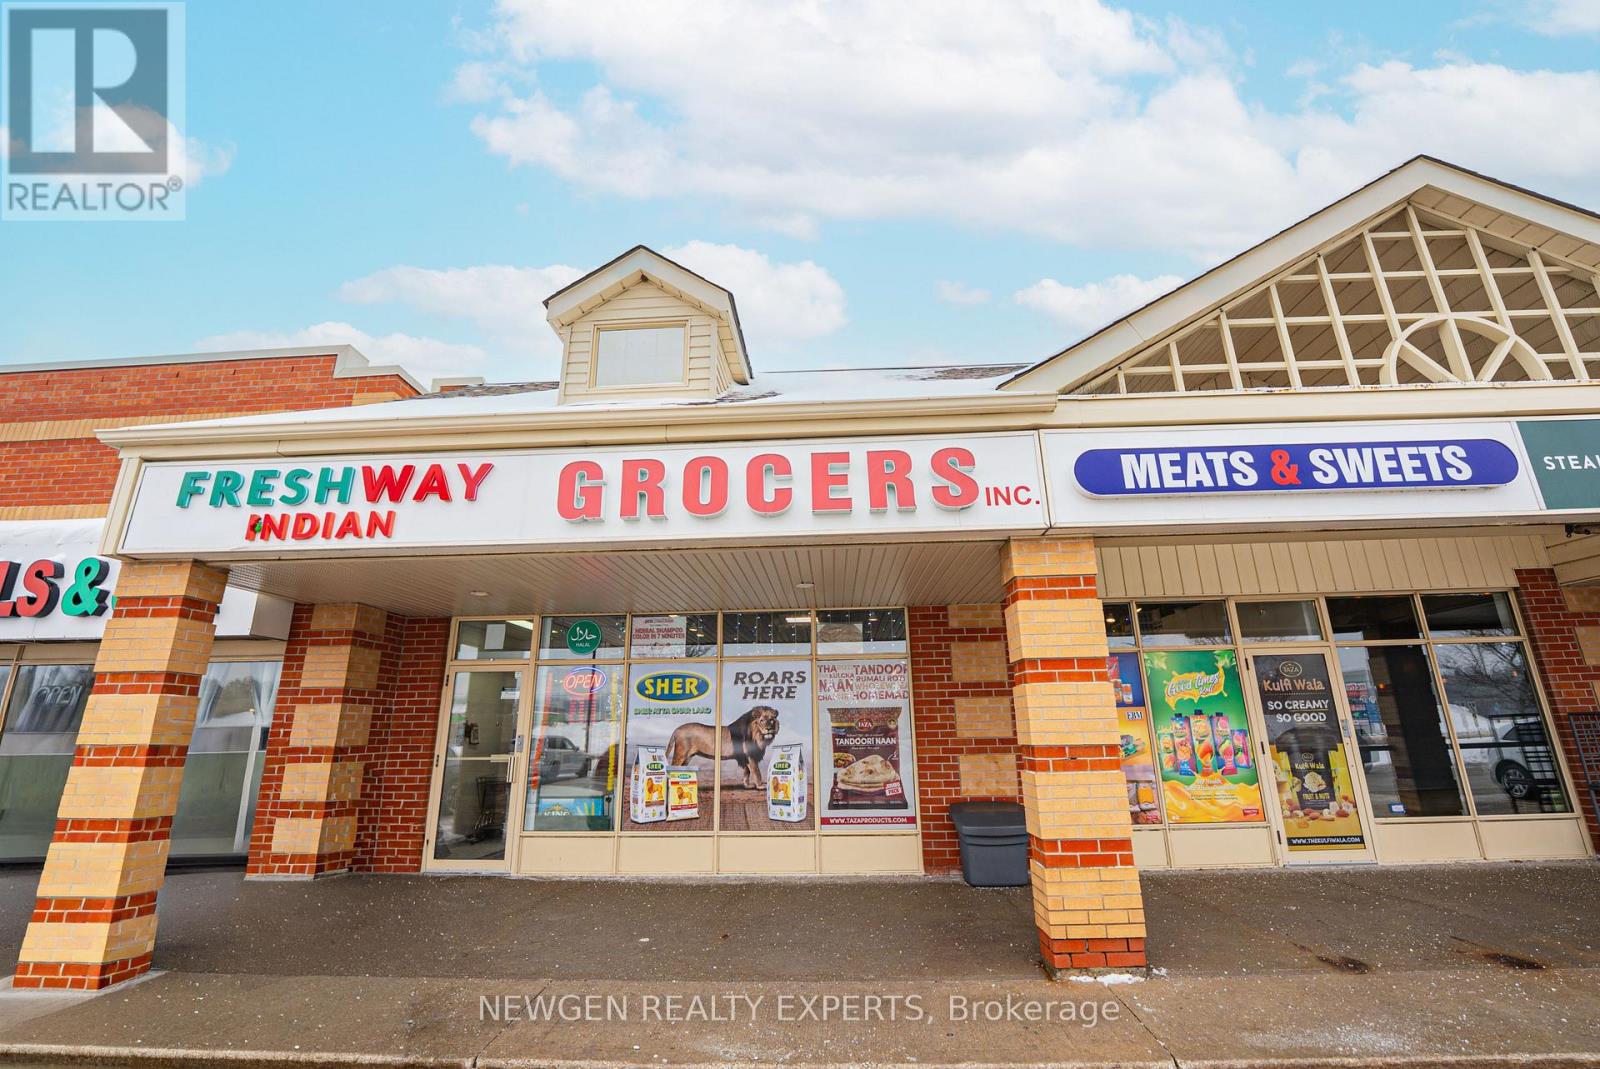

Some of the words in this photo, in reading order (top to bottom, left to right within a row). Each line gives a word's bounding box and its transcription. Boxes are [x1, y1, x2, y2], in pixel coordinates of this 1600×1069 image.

[1120, 451, 1258, 489] MEATS
[1270, 449, 1301, 486] &
[1309, 445, 1473, 483] SWEETS
[175, 463, 494, 508] FRESHWAY
[557, 447, 980, 522] GROCERS
[985, 485, 1041, 507] INC.
[245, 510, 396, 541] INDIAN
[61, 557, 109, 616] &
[566, 675, 602, 688] OPEN
[734, 671, 807, 685] ROARS
[1263, 678, 1292, 692] Kulfi
[645, 678, 698, 696] SHER
[742, 686, 798, 700] HERE
[819, 680, 853, 692] NAAN
[1267, 701, 1283, 710] SO
[1284, 699, 1329, 710] CREAMY
[1276, 713, 1292, 723] SO
[1293, 712, 1327, 722] GOOD
[876, 737, 897, 745] NAAN
